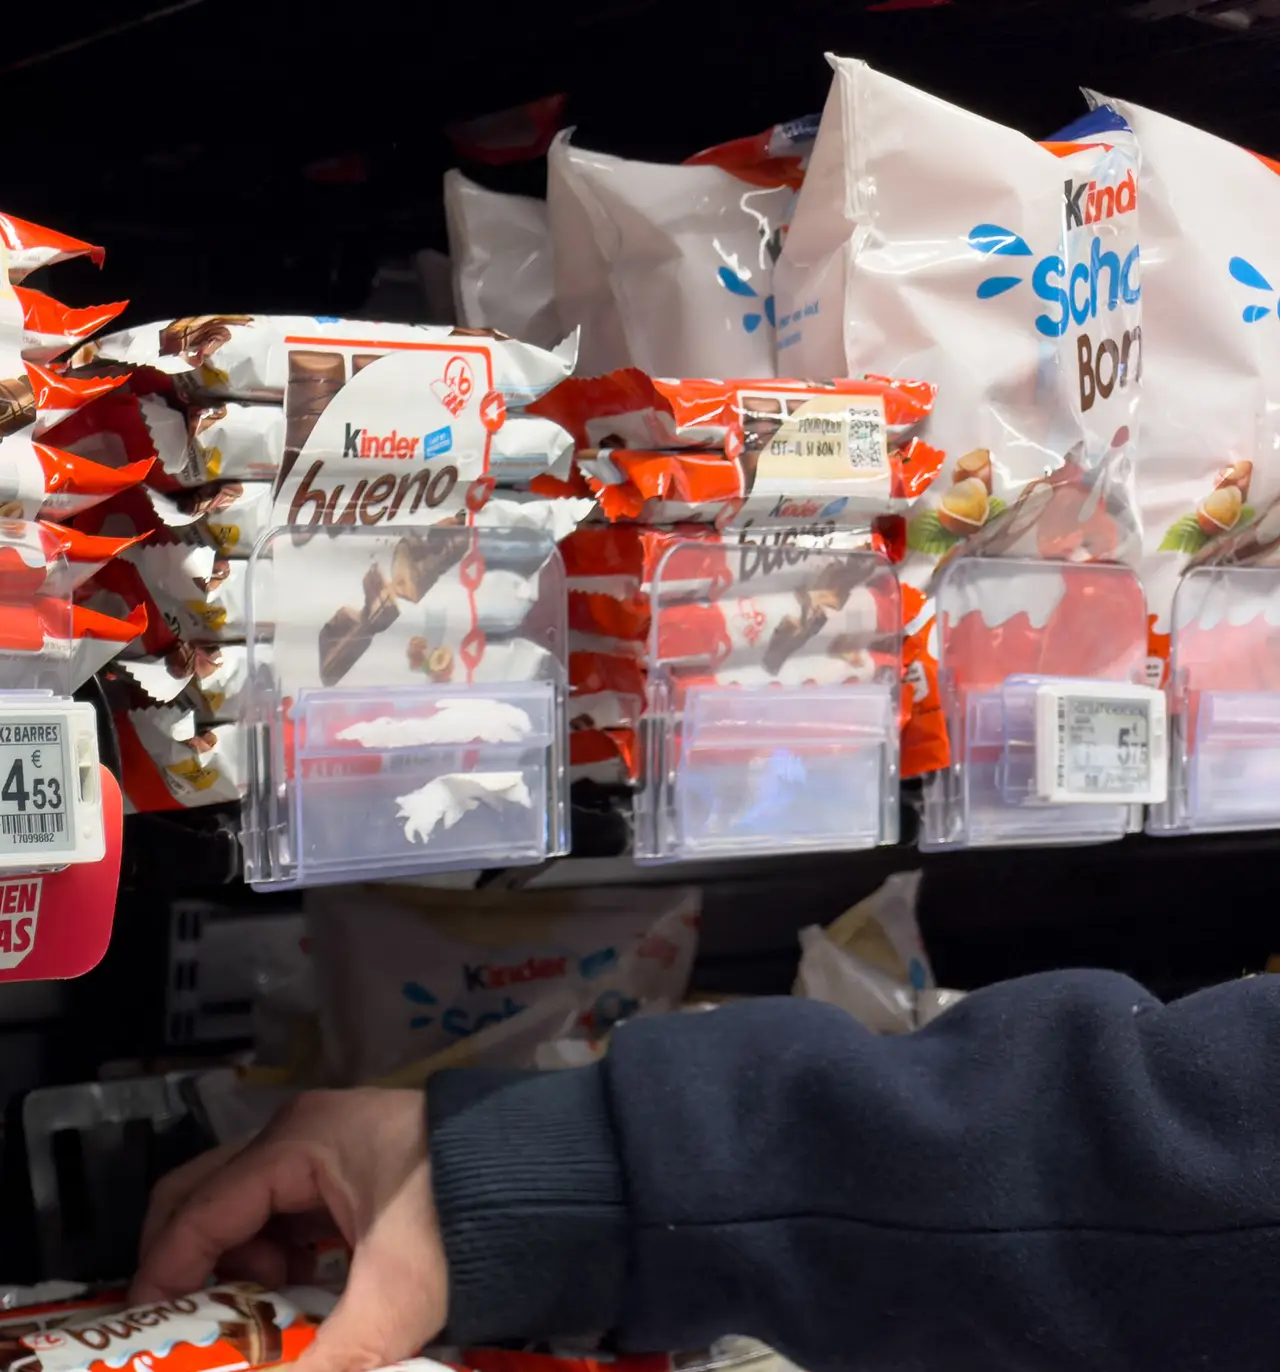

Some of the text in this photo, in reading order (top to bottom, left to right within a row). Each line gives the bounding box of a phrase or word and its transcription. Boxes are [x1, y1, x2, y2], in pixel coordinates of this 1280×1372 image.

[1064, 168, 1139, 231] Kind
[343, 422, 419, 460] Kinder
[286, 459, 459, 547] bueno
[14, 725, 58, 743] BARRES
